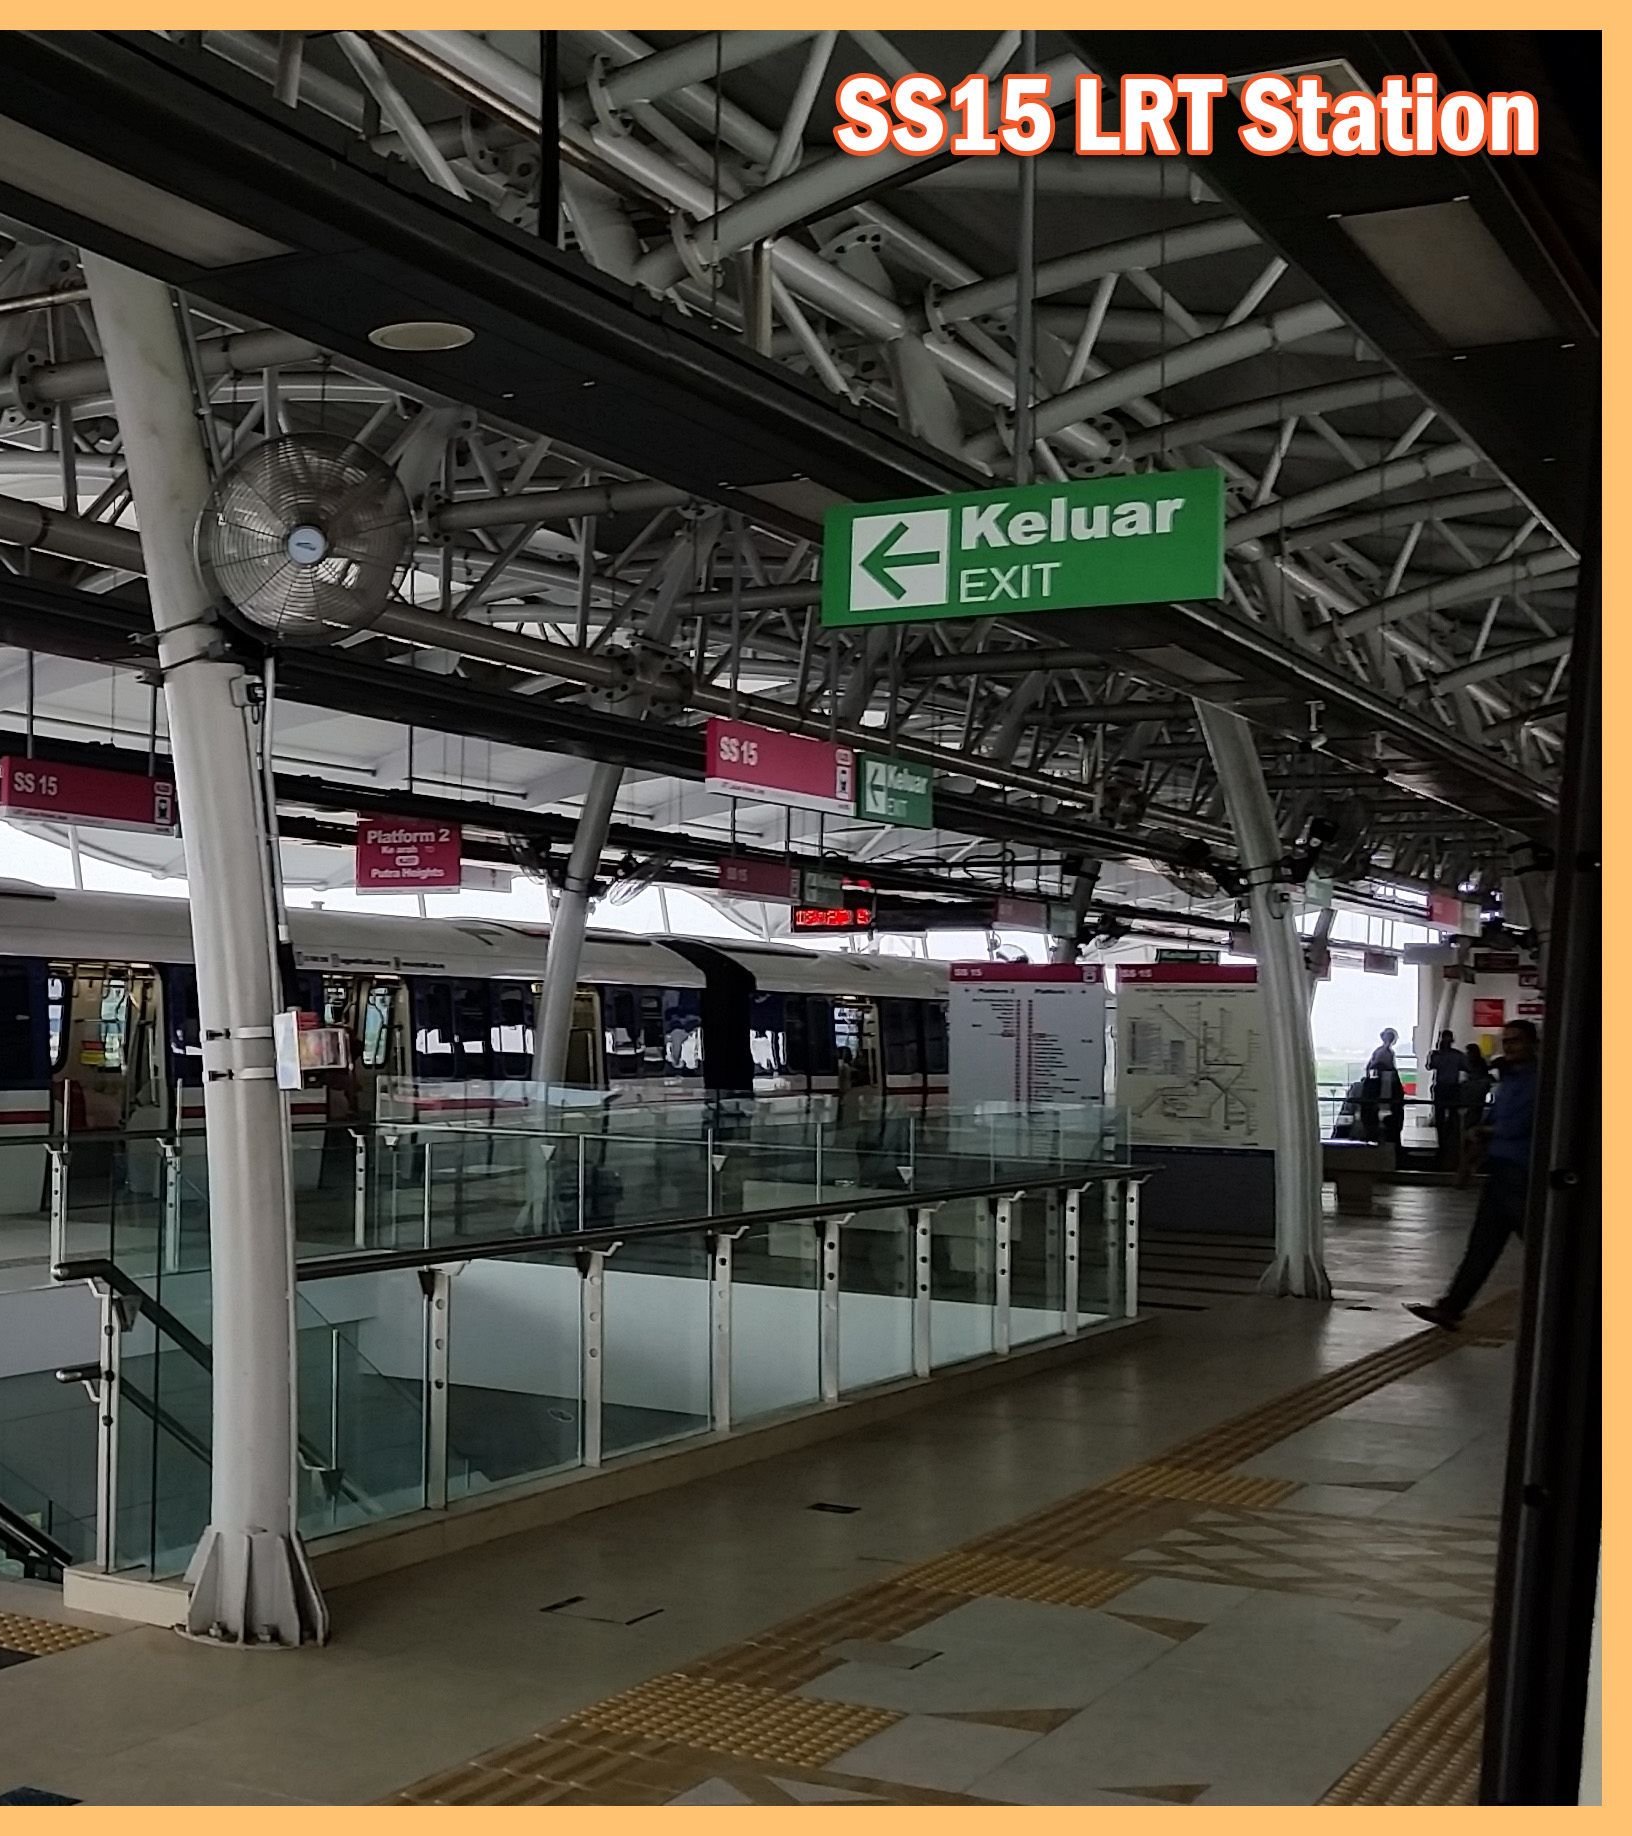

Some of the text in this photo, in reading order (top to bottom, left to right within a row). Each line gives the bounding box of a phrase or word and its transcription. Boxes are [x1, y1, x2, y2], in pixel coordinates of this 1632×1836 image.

[960, 496, 1187, 551] Keluar
[959, 562, 1063, 604] EXIT
[719, 735, 758, 766] SS 15
[13, 772, 58, 796] SS 15
[366, 828, 450, 845] Platform 2
